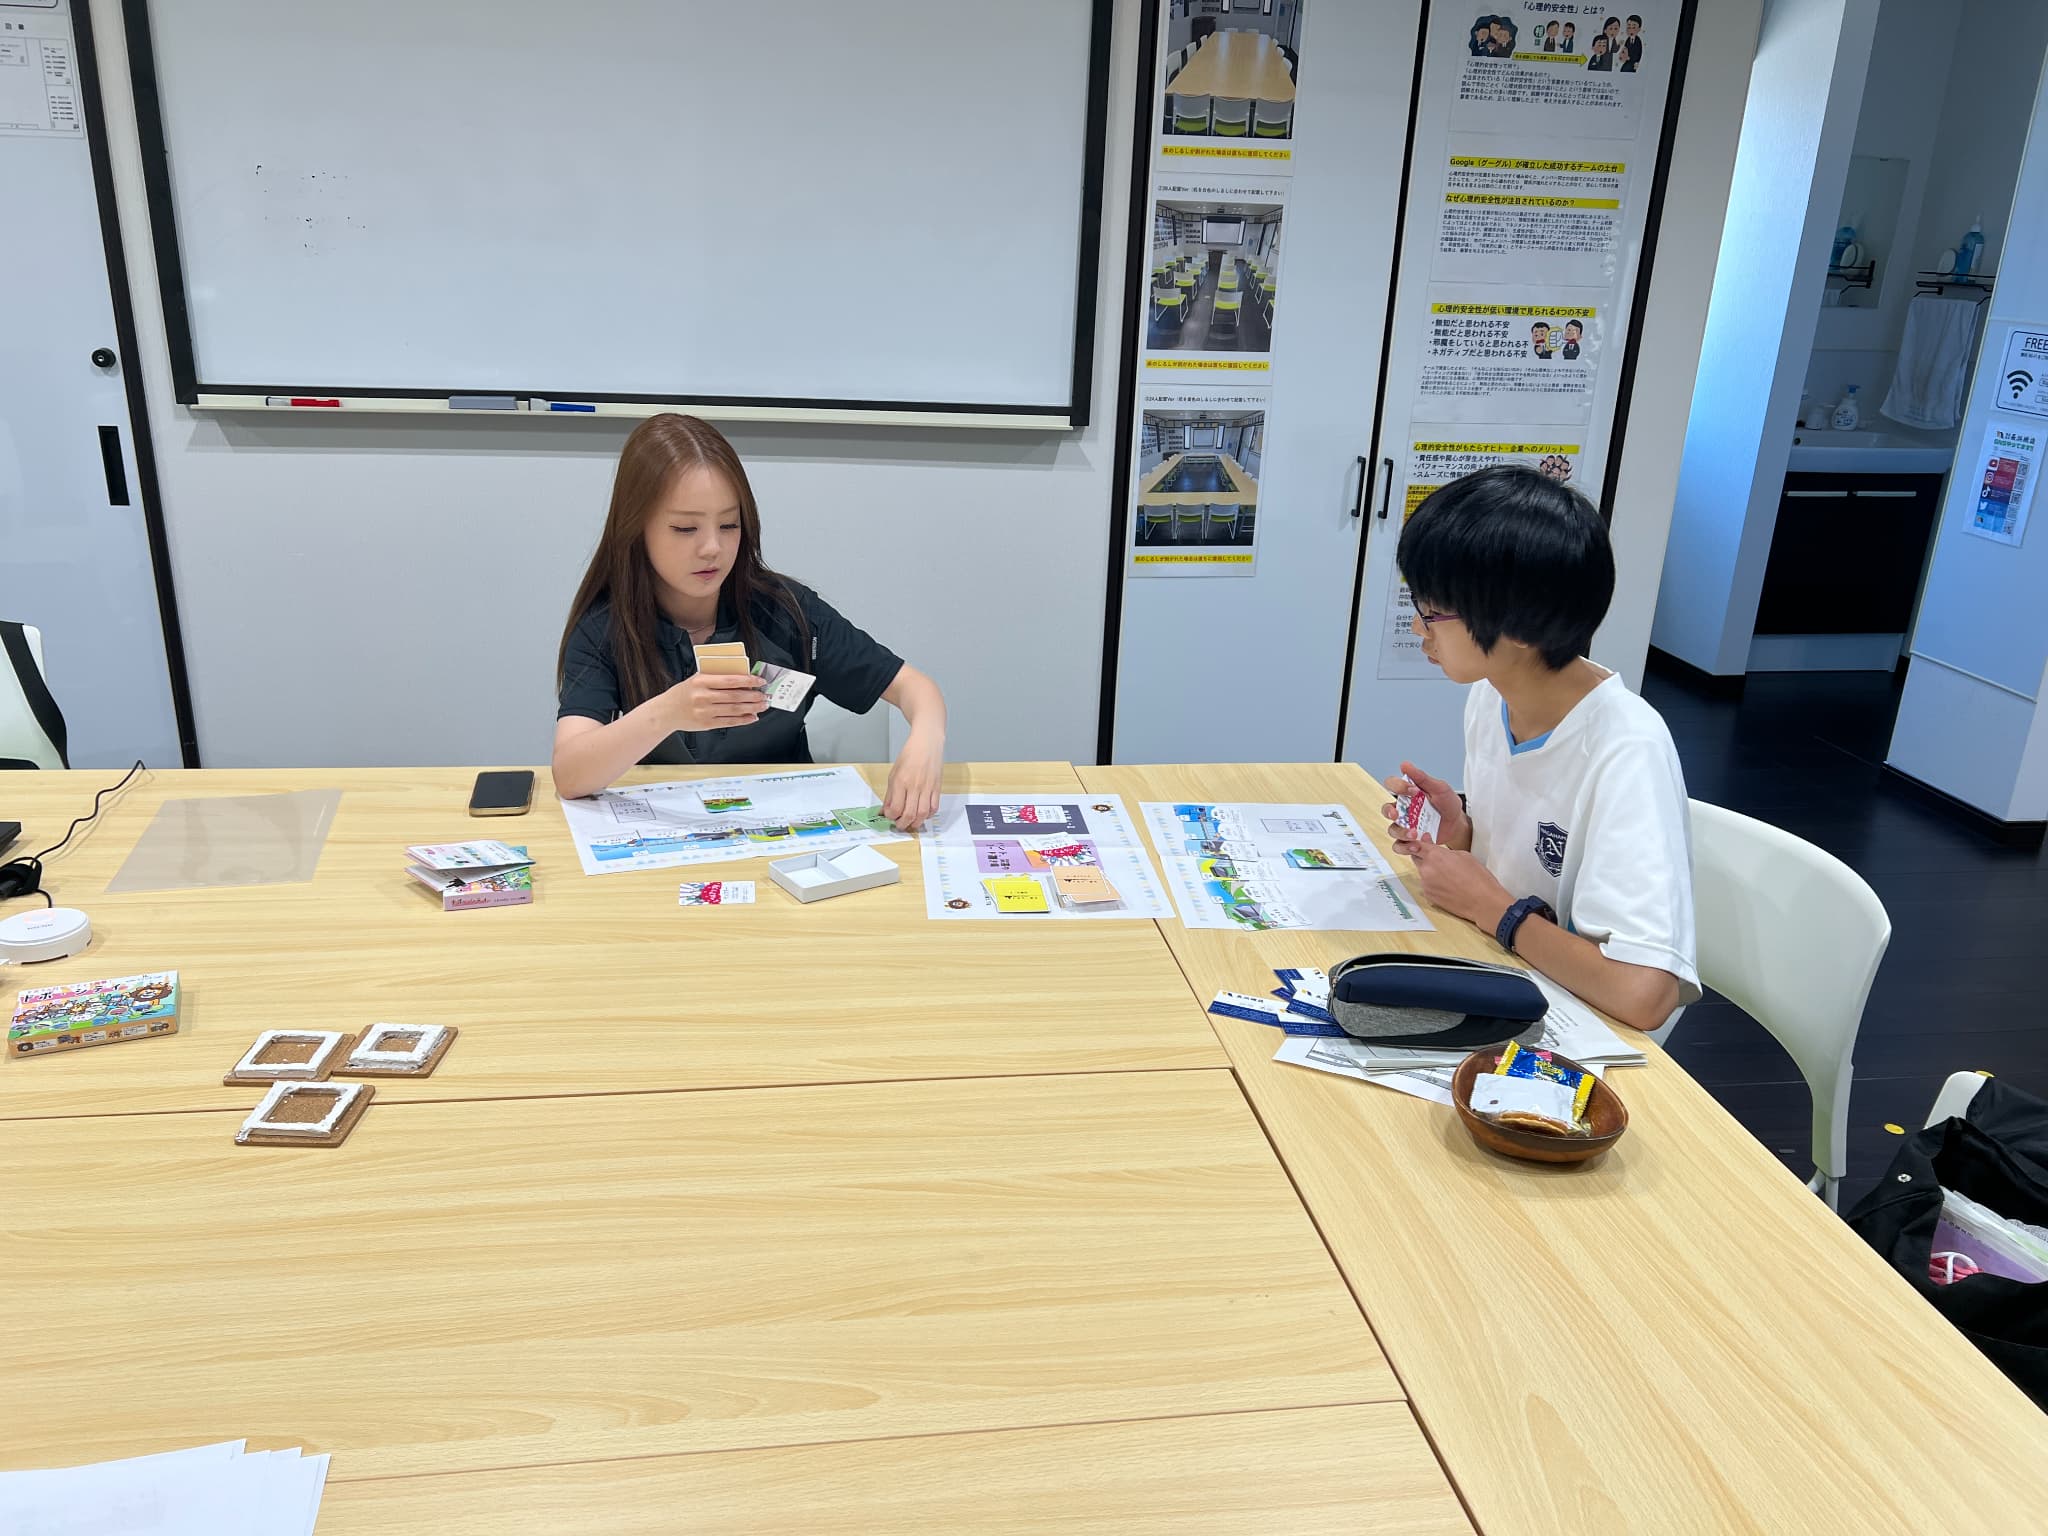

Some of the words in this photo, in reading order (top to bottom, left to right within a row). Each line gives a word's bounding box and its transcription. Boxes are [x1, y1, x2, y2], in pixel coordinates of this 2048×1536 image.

[1446, 194, 1575, 207] なぜ心理的安全性が注目されているのか？
[1438, 304, 1590, 317] 心理的安全性が低い環境で見られる4つの不安
[2025, 337, 2048, 351] FREE
